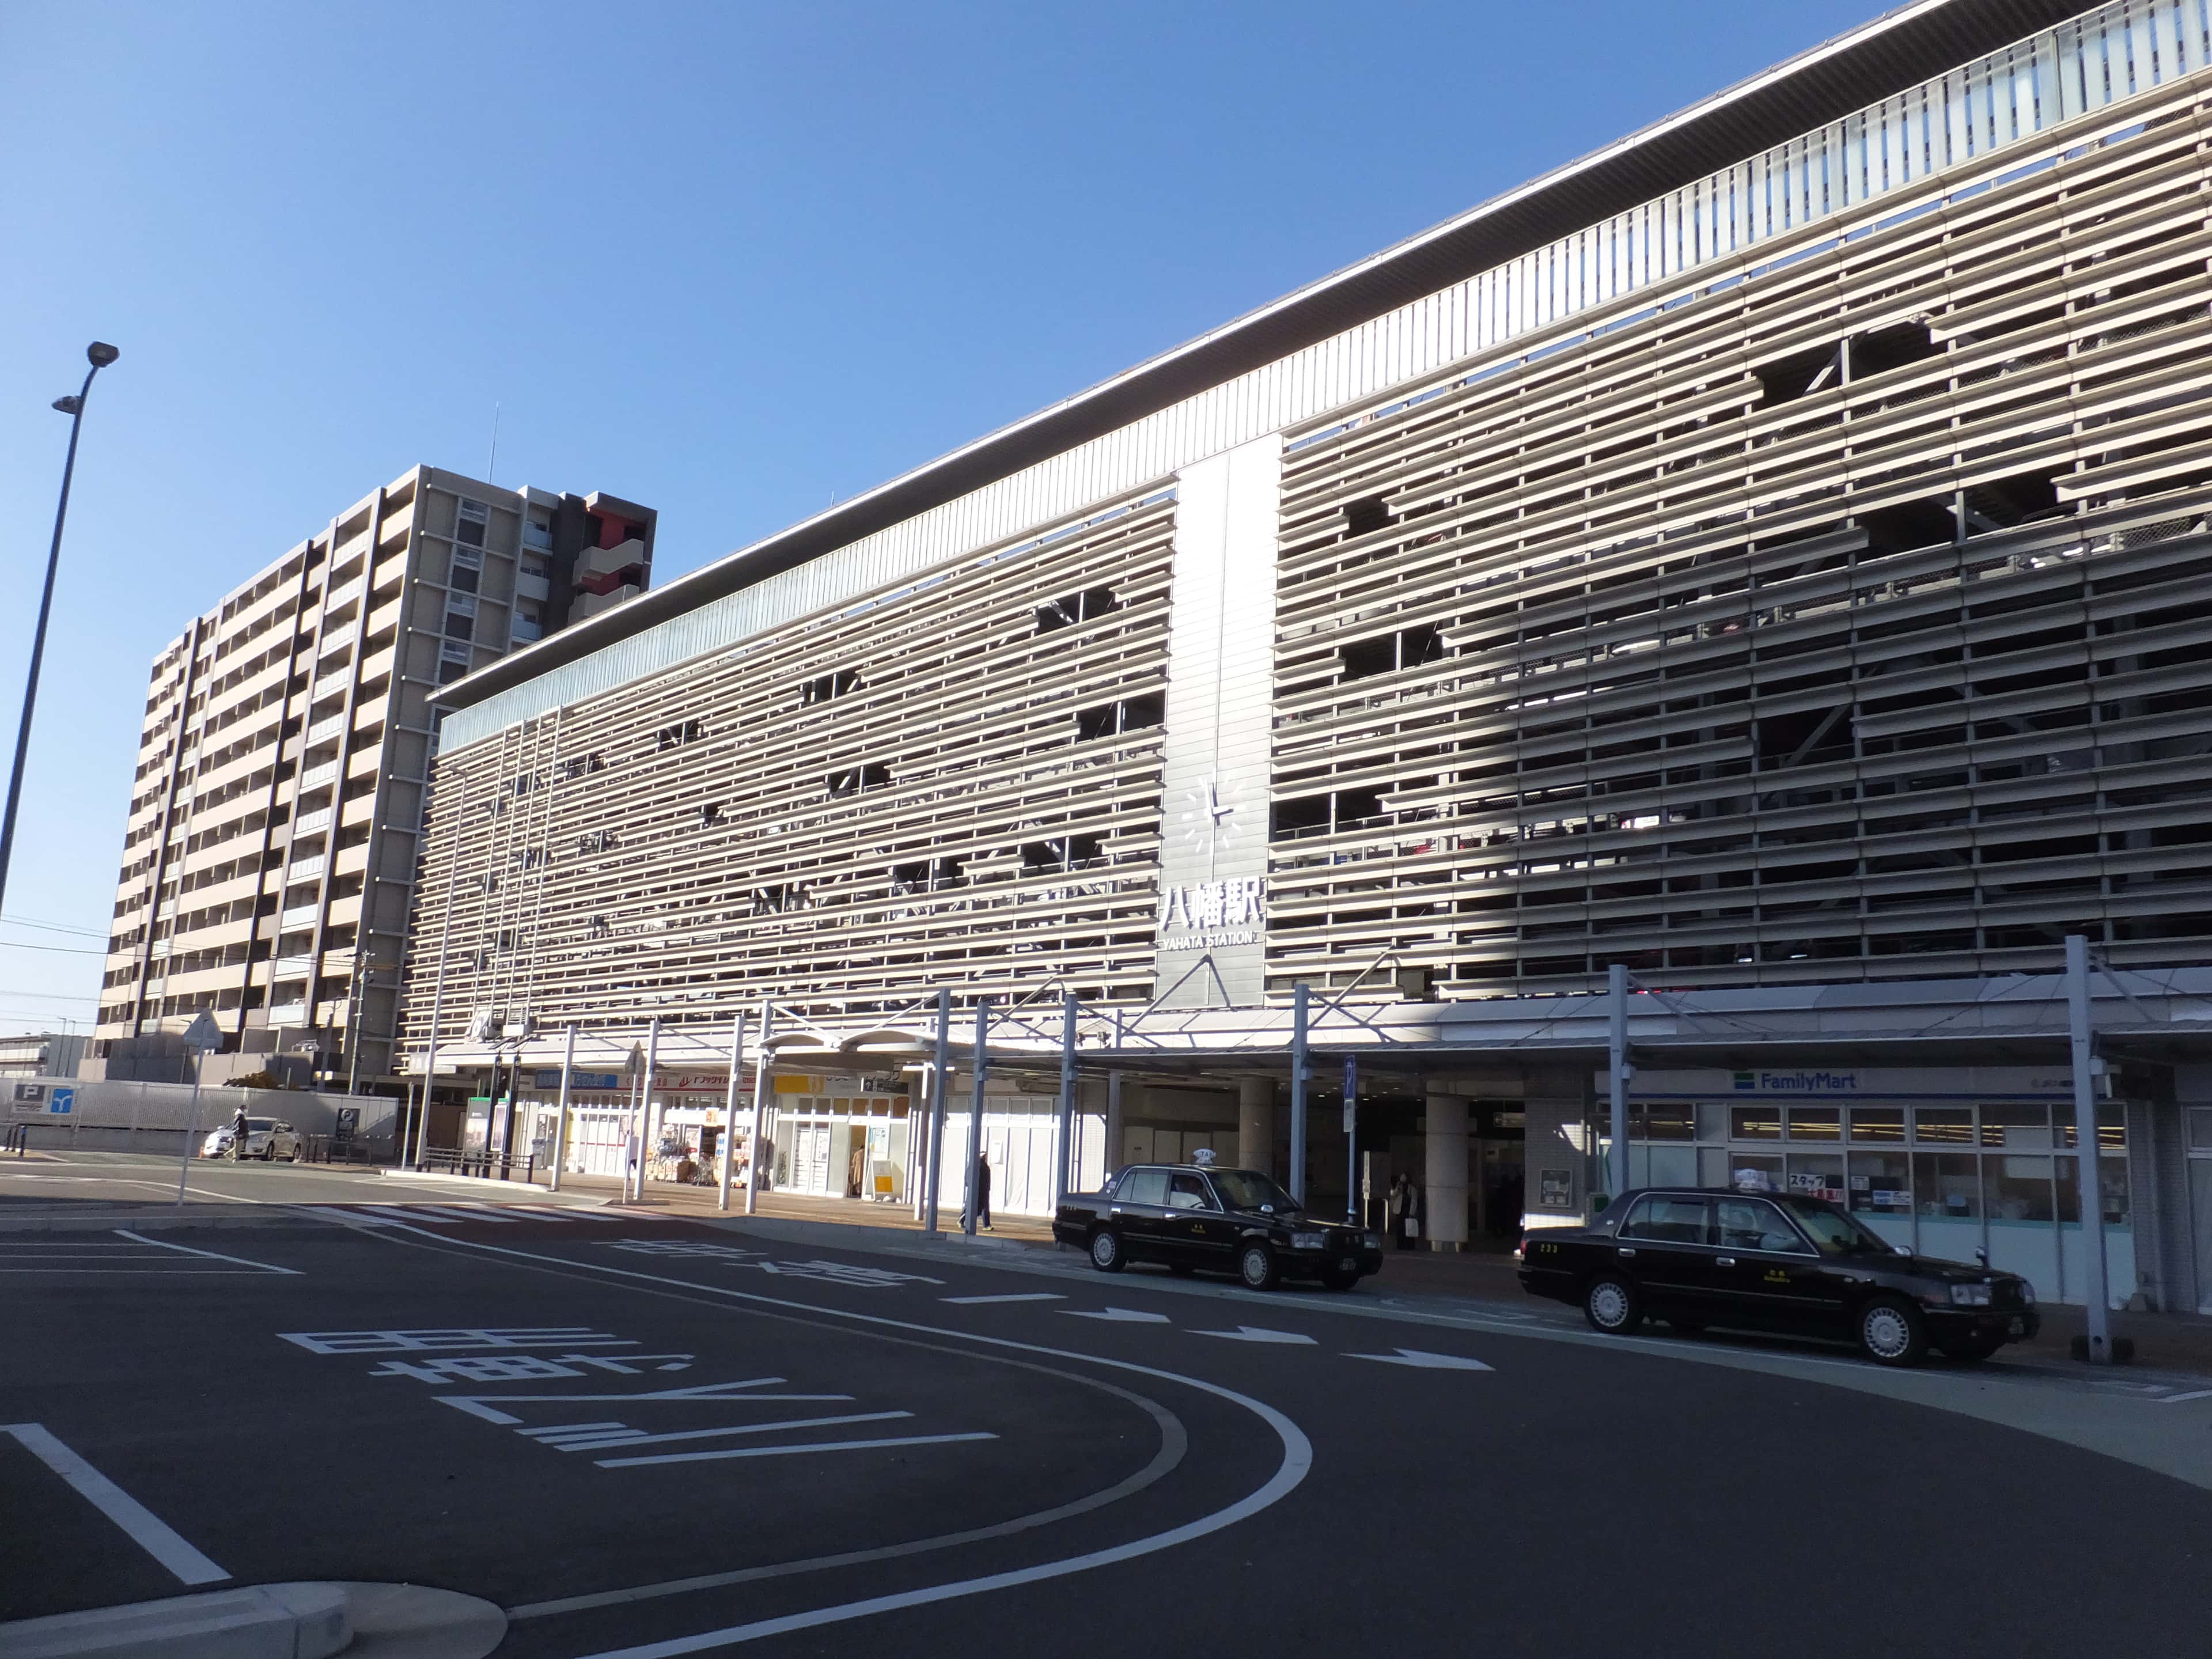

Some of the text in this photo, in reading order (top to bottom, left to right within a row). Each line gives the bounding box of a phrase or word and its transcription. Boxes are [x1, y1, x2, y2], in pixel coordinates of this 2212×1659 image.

[1159, 875, 1261, 930] 八幡駅
[1162, 930, 1253, 950] YAHATA STATION
[1761, 1072, 1857, 1091] FamilyMart
[23, 1086, 39, 1099] P
[1790, 1175, 1824, 1187] スタッフ
[275, 1327, 1001, 1468] バス専用
